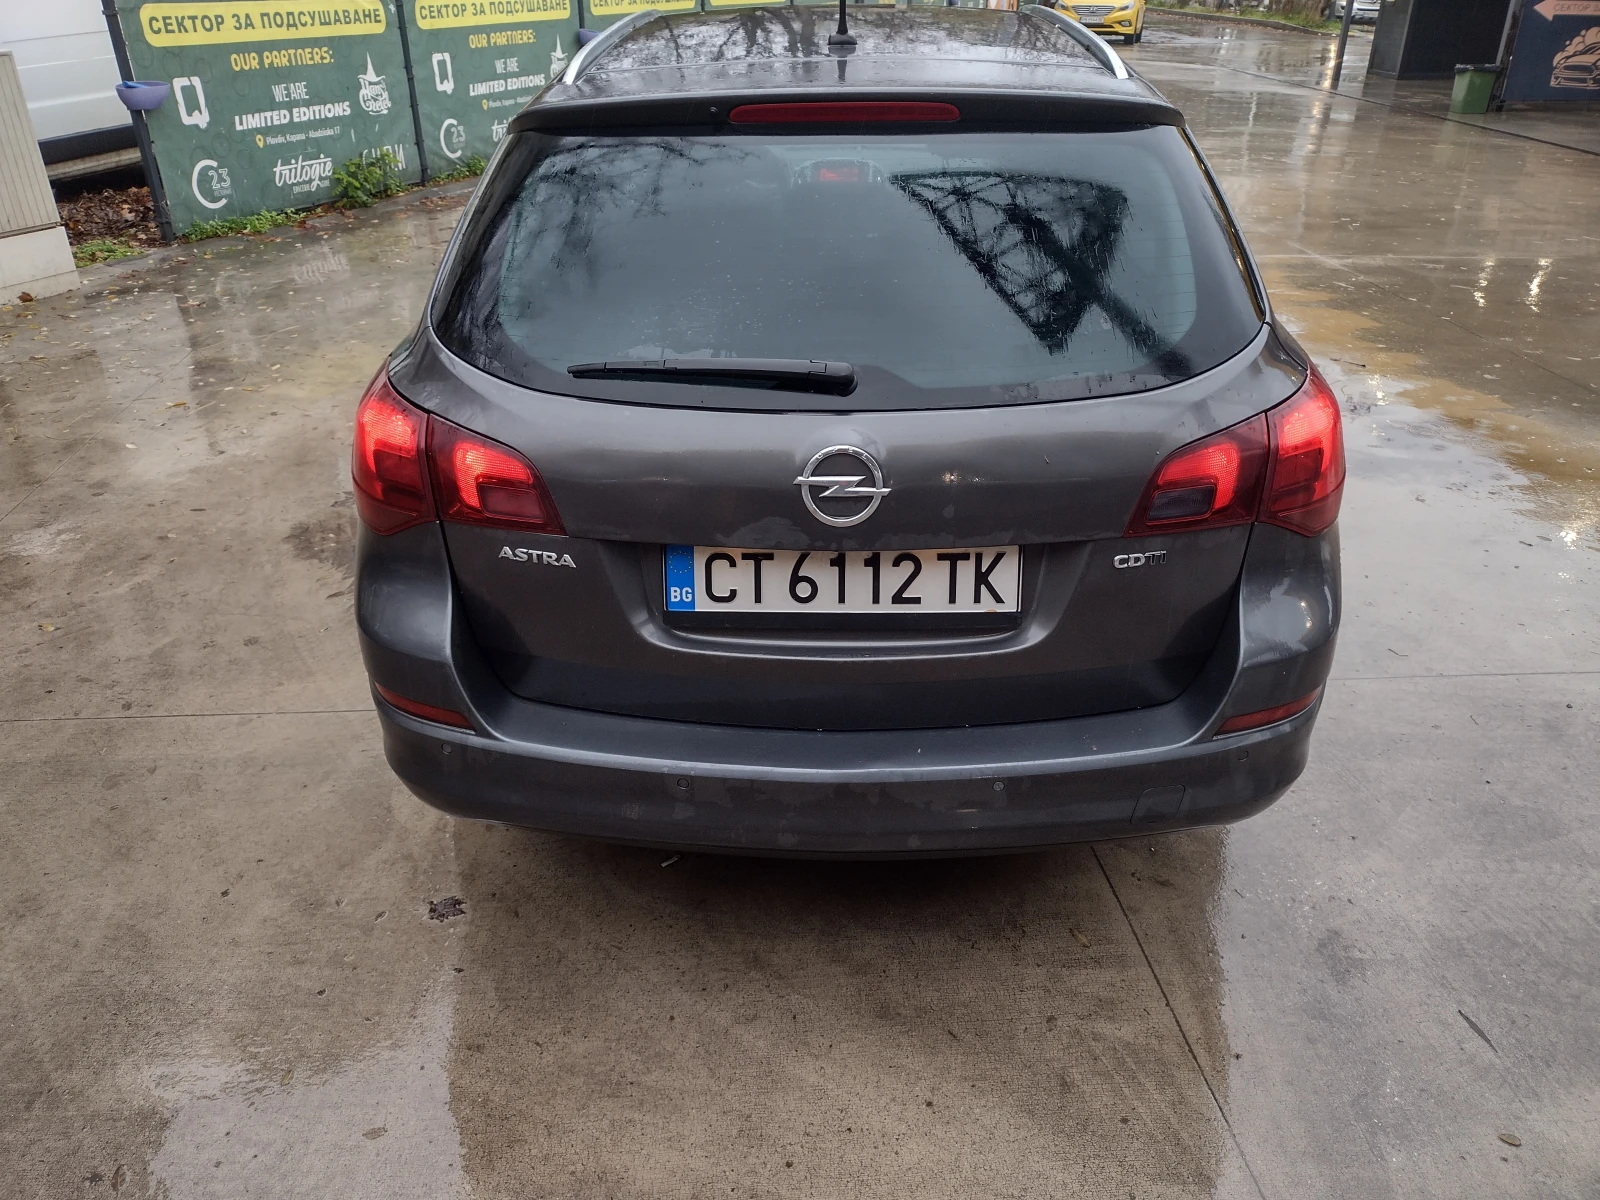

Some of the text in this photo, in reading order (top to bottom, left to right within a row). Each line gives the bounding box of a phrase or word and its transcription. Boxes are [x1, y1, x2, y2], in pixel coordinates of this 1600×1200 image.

[419, 0, 568, 20] СЕКТОР ЗА ПОДСУШАВАНЕ
[1554, 3, 1591, 12] СЕКТОР
[148, 8, 382, 34] СЕКТОР ЗА ПОДСУШАВАНЕ
[469, 29, 536, 49] OUR PARTNERS:
[230, 46, 335, 72] OUR PARTNERS:
[494, 58, 506, 74] WE
[271, 82, 310, 102] WE ARE
[469, 73, 546, 96] LIMITED EDITIONS
[234, 101, 352, 131] LIMITED EDITIONS
[450, 125, 466, 143] 23
[208, 168, 231, 189] 23
[273, 153, 333, 191] trilogie
[498, 546, 577, 568] ASTRA
[1113, 550, 1167, 568] CDTI
[705, 552, 1006, 605] CT 6112 TK
[670, 587, 693, 602] BG
